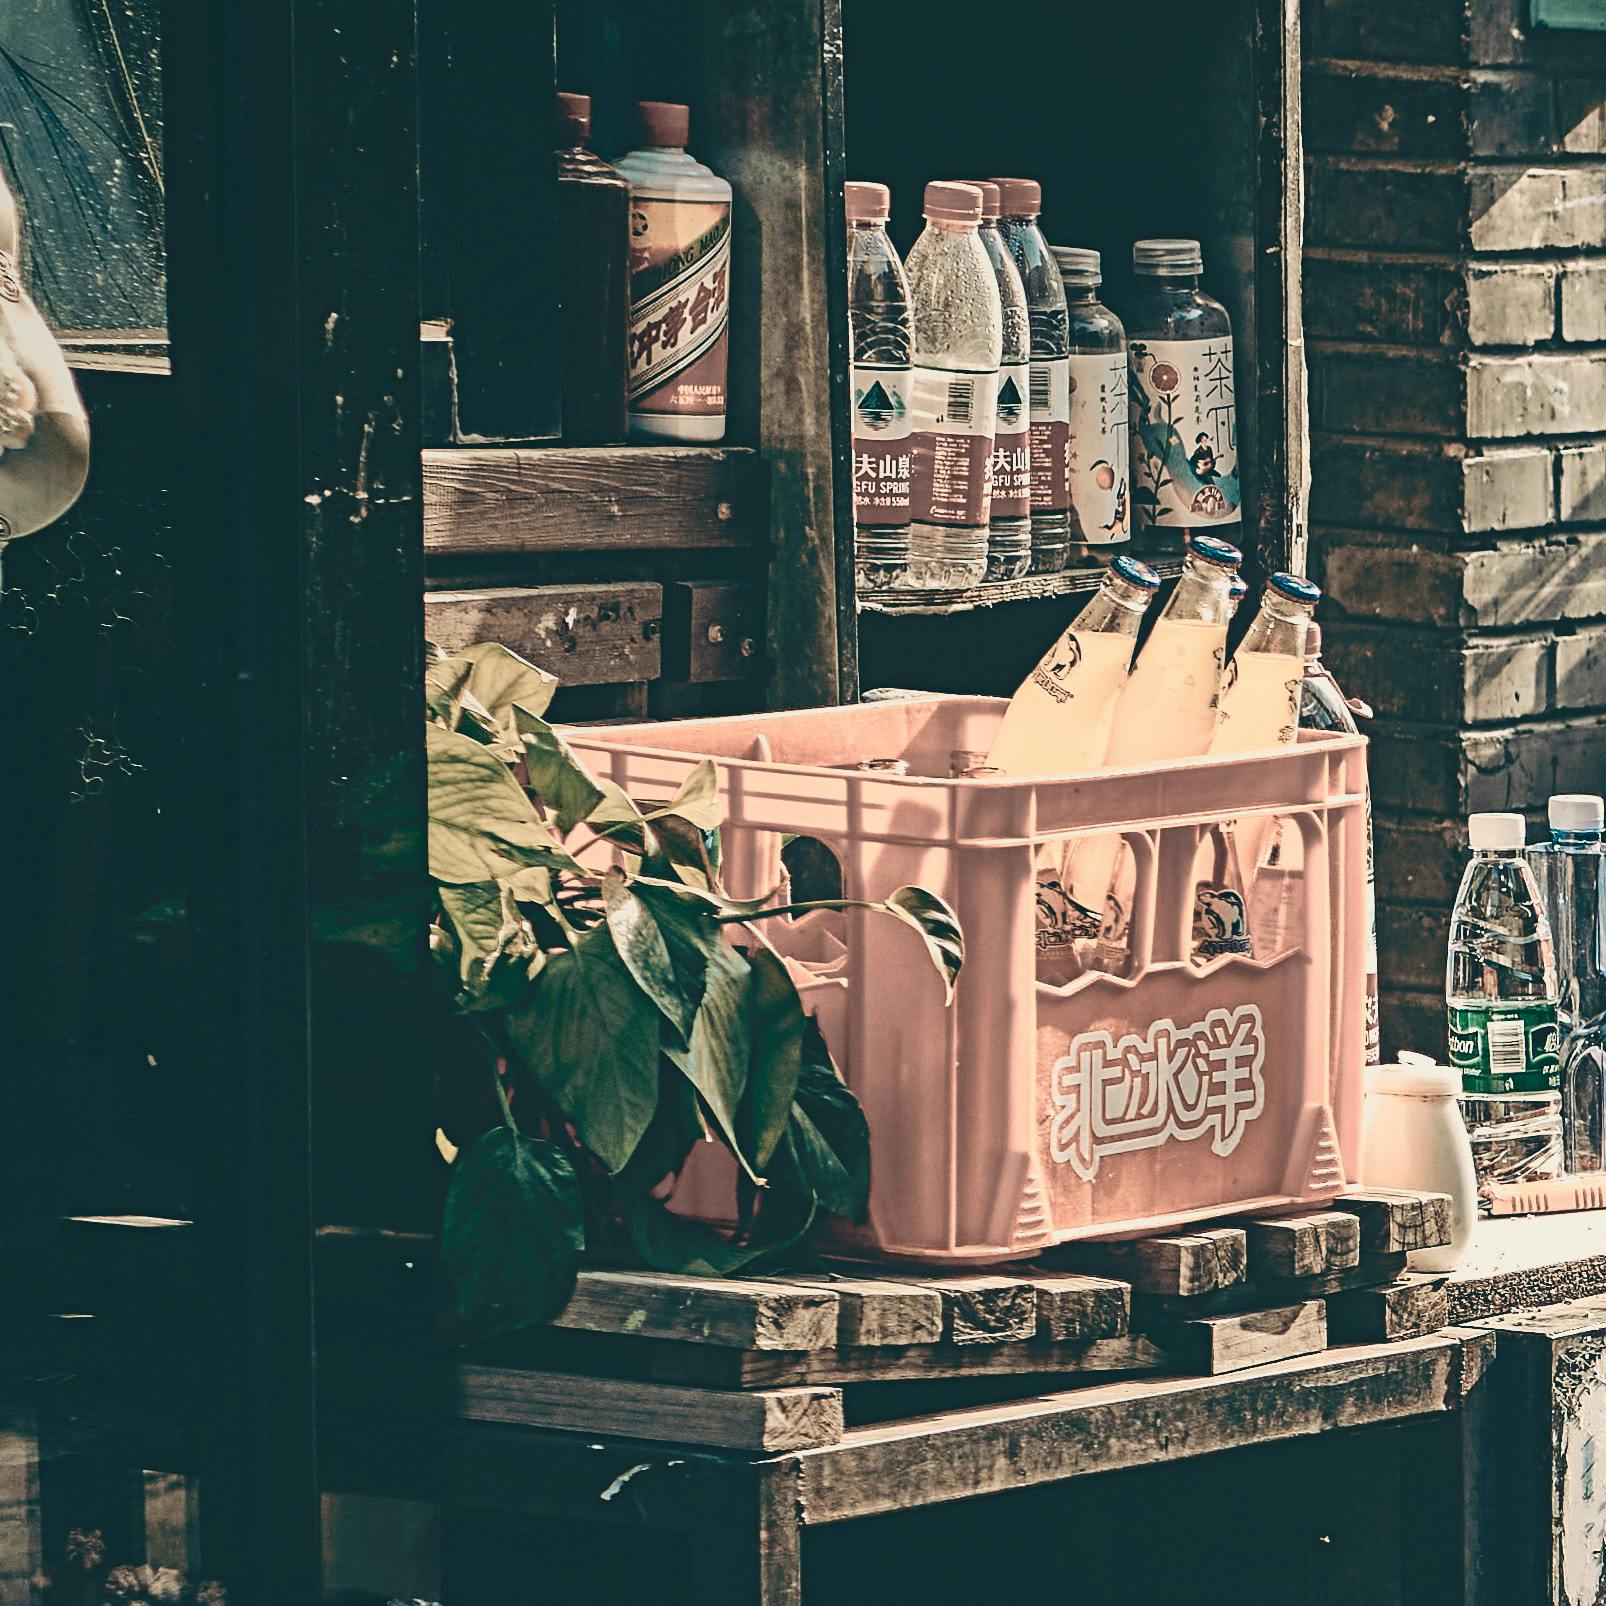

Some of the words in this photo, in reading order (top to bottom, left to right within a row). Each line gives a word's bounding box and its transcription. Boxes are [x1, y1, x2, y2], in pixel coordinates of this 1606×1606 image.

[854, 454, 911, 479] 夫山泉
[1054, 1009, 1262, 1174] 北冰洋
